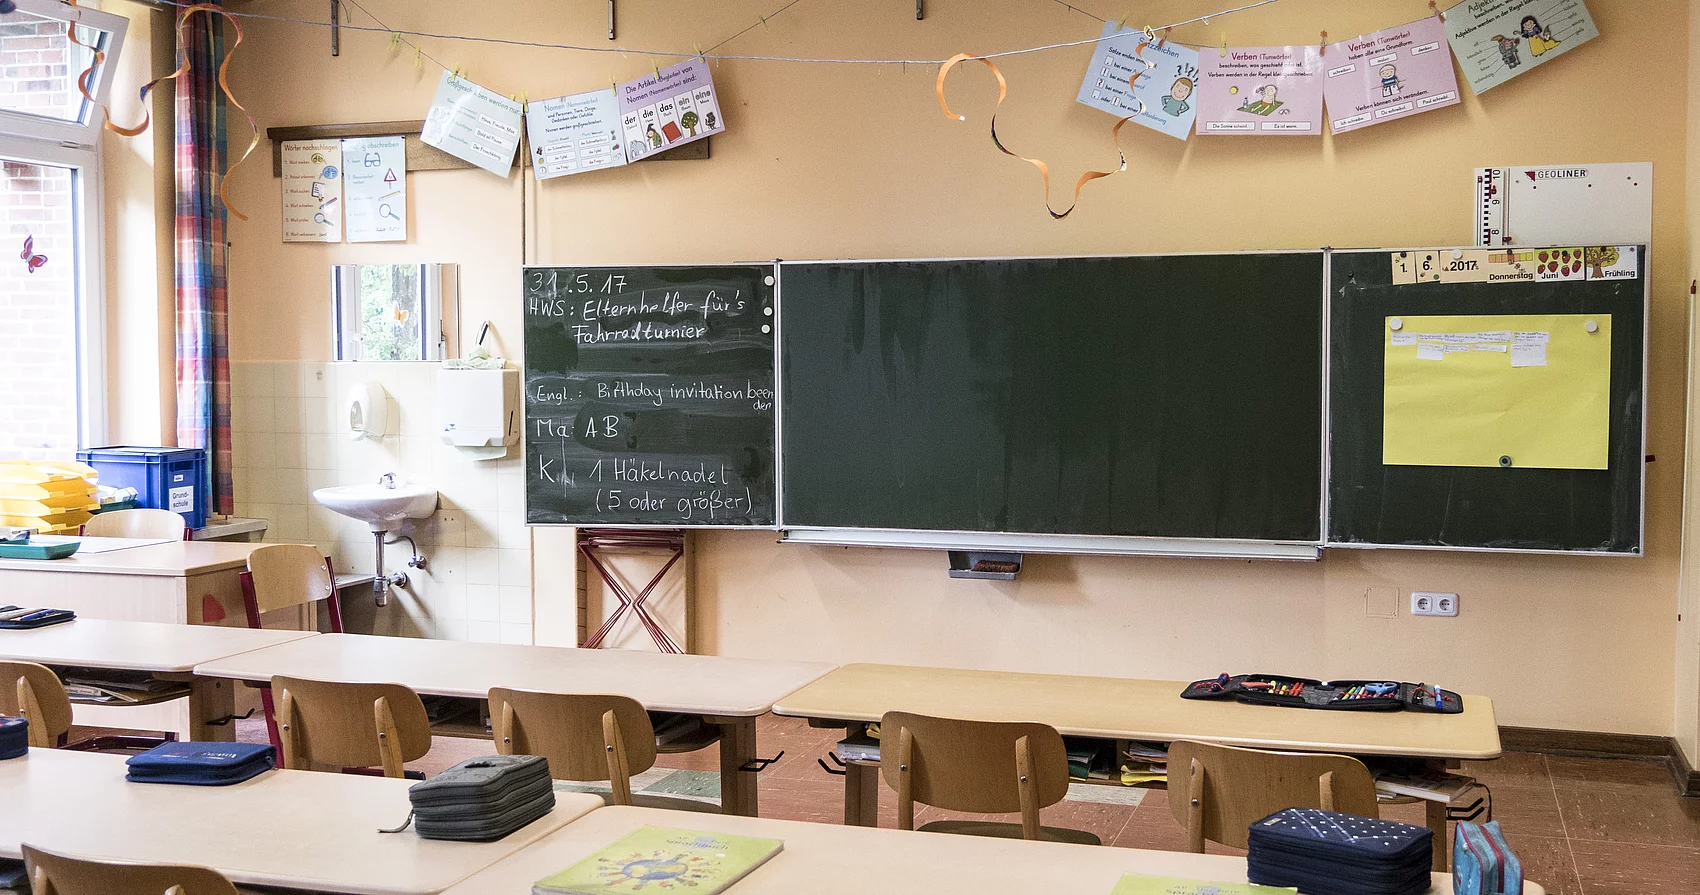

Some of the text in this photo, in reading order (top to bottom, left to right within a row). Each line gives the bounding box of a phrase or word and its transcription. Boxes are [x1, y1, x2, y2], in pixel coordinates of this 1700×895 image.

[1474, 3, 1504, 19] beschreiben,
[1455, 26, 1477, 39] Adjektive
[1477, 17, 1495, 28] werden
[1508, 4, 1524, 13] Regel
[1348, 31, 1411, 52] Verben (Tunwörter)
[1139, 37, 1180, 58] Stzzeichen
[1348, 53, 1364, 61] haben
[1365, 49, 1374, 57] alle
[1386, 40, 1414, 51] Grundform.
[1121, 52, 1135, 62] enden
[1231, 52, 1258, 60] Verben
[1121, 65, 1132, 73] einer
[1258, 71, 1272, 79] Regel
[625, 85, 637, 95] Die
[637, 78, 657, 91] Artikel
[681, 66, 693, 75] von
[626, 92, 649, 105] Nomen
[682, 73, 698, 85] sind:
[1112, 87, 1124, 95] einer
[1124, 90, 1137, 100] Frage
[695, 90, 711, 101] eine
[488, 98, 509, 110] werden
[678, 96, 690, 106] ein
[1355, 91, 1429, 112] Verben können sich verändern.
[544, 102, 565, 112] Nomen
[659, 103, 673, 113] das
[1127, 105, 1138, 113] einer
[555, 110, 573, 118] Personen,
[642, 109, 654, 119] die
[624, 116, 636, 125] der
[302, 144, 338, 153] nachschlagen
[367, 141, 399, 150] abschreiben
[1492, 169, 1501, 180] 10
[1537, 169, 1586, 179] GEOLINER
[1400, 260, 1477, 273] 1. 6. 2017
[1489, 271, 1534, 281] Donnerstag
[1541, 271, 1559, 280] Juni
[1604, 269, 1636, 279] Frühling
[529, 289, 745, 321] HWS: Elternhelfer für's
[571, 321, 706, 344] Fahrradturnier
[670, 382, 743, 399] invitation
[589, 459, 603, 482] 1
[614, 457, 729, 485] Häkelnadel
[172, 491, 190, 499] Grund-
[172, 500, 189, 508] schule
[629, 490, 667, 512] oder
[677, 487, 753, 519] größer)
